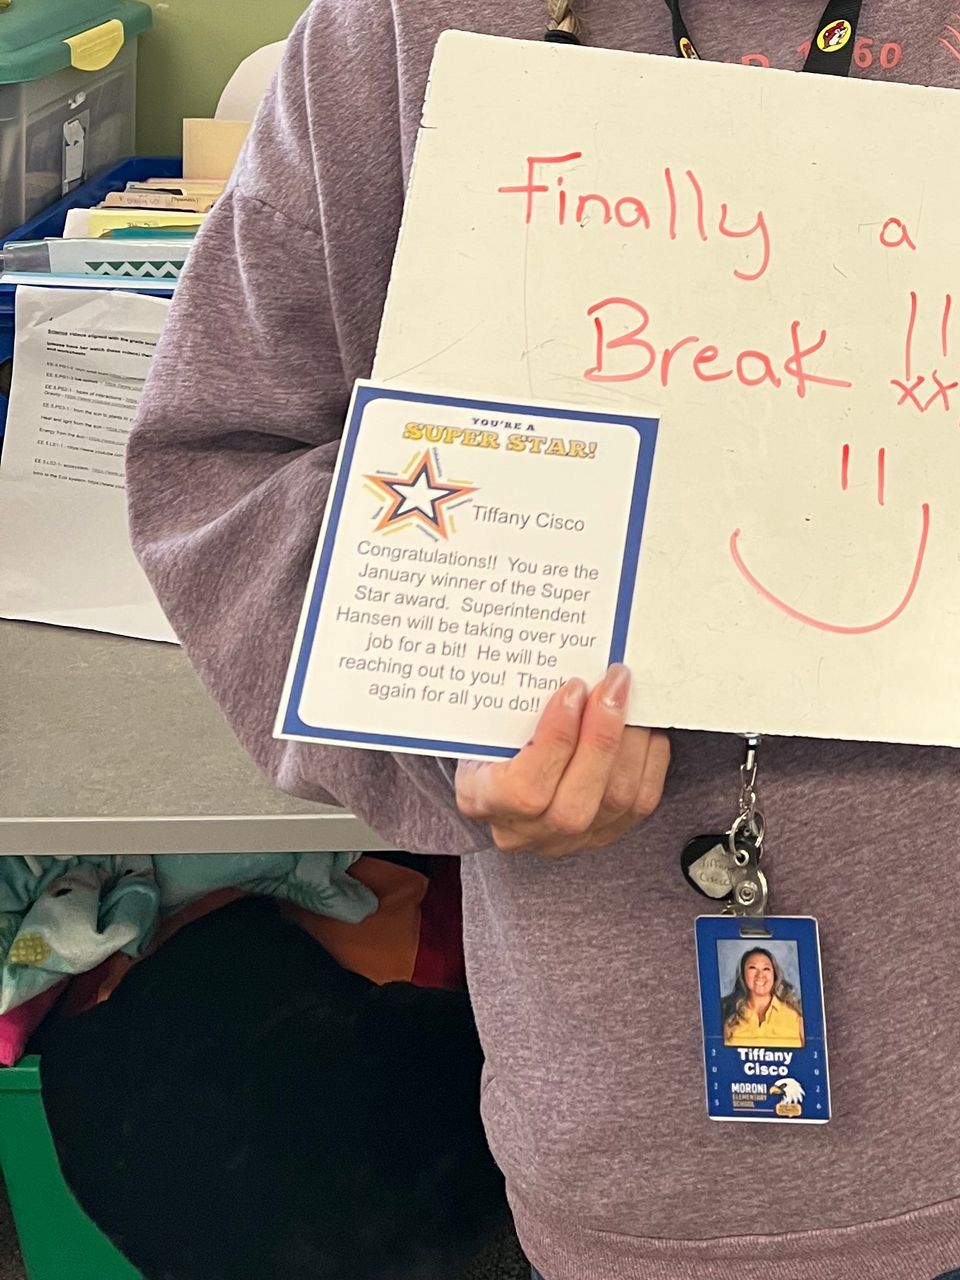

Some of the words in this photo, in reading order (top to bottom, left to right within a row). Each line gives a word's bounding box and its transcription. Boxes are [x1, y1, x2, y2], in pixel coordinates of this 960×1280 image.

[497, 150, 771, 281] Finally
[878, 216, 917, 252] a
[584, 297, 852, 398] Break
[402, 422, 501, 449] SUPER
[506, 434, 598, 459] STAR!
[472, 417, 521, 432] YOU'RE
[526, 424, 536, 432] A
[472, 505, 530, 529] Tiffany
[536, 512, 586, 532] Cisco
[357, 540, 497, 570] Congratulations!!
[507, 556, 538, 575] You
[542, 565, 569, 578] are
[573, 563, 599, 580] the
[358, 563, 426, 587] January
[430, 573, 486, 590] winner
[490, 578, 507, 594] of
[511, 580, 536, 597] the
[540, 583, 590, 603] Super
[354, 585, 391, 602] Star
[395, 592, 449, 610] award.
[461, 597, 586, 625] Superintendent
[336, 606, 402, 628] Hansen
[407, 615, 434, 631] will
[438, 618, 460, 635] be
[464, 622, 514, 643] taking
[518, 629, 555, 644] over
[559, 634, 596, 650] your
[365, 632, 394, 652] job
[398, 637, 421, 653] for
[425, 643, 435, 655] a
[440, 641, 468, 658] bit!
[477, 646, 501, 662] He
[506, 649, 532, 666] will
[537, 652, 558, 668] be
[339, 654, 413, 681] reaching
[418, 664, 445, 679] out
[449, 666, 466, 682] to
[471, 669, 507, 688] you!
[368, 682, 416, 702] again
[421, 686, 445, 703] for
[449, 688, 468, 706] all
[472, 694, 504, 712] you
[508, 694, 540, 714] do!!
[737, 1048, 793, 1065] Tiffany
[743, 1062, 789, 1076] Cisco
[731, 1082, 767, 1095] MORONI
